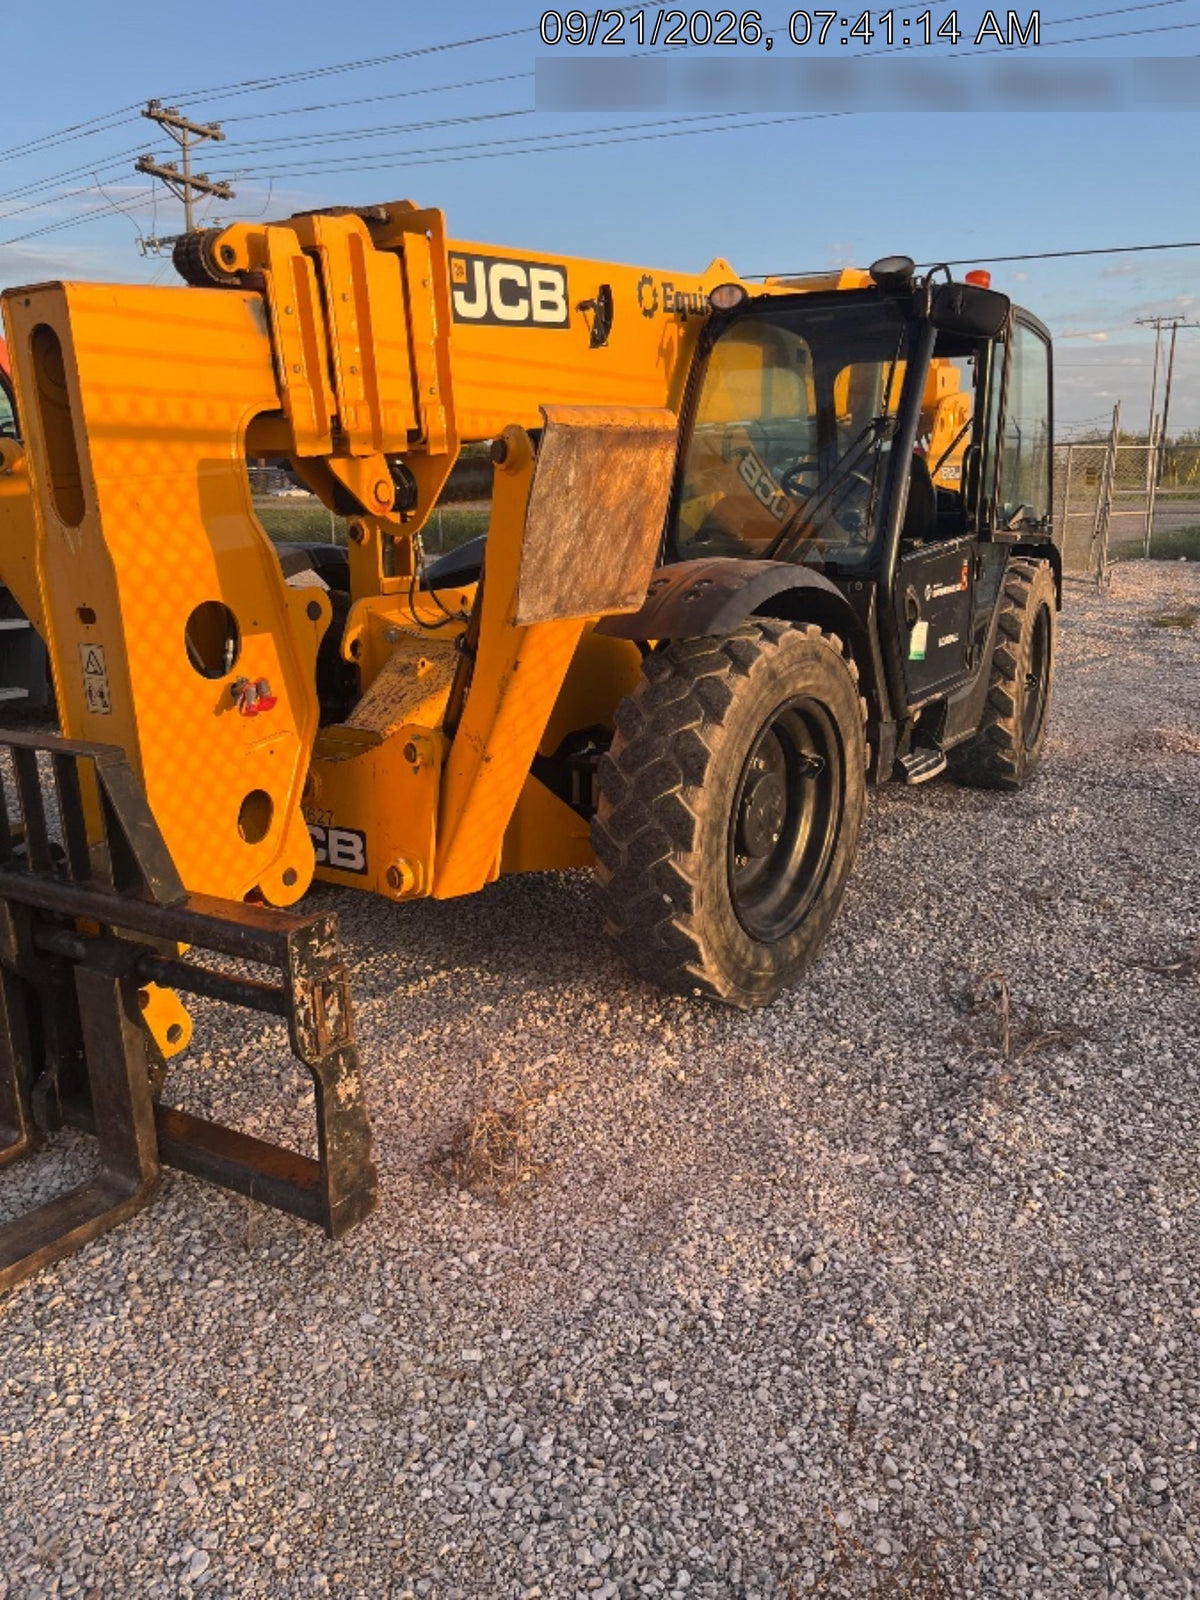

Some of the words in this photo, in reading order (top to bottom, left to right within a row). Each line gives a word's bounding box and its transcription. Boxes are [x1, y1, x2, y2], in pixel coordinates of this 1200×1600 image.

[453, 260, 567, 322] JCB
[304, 806, 334, 826] 627
[305, 824, 366, 871] CB
